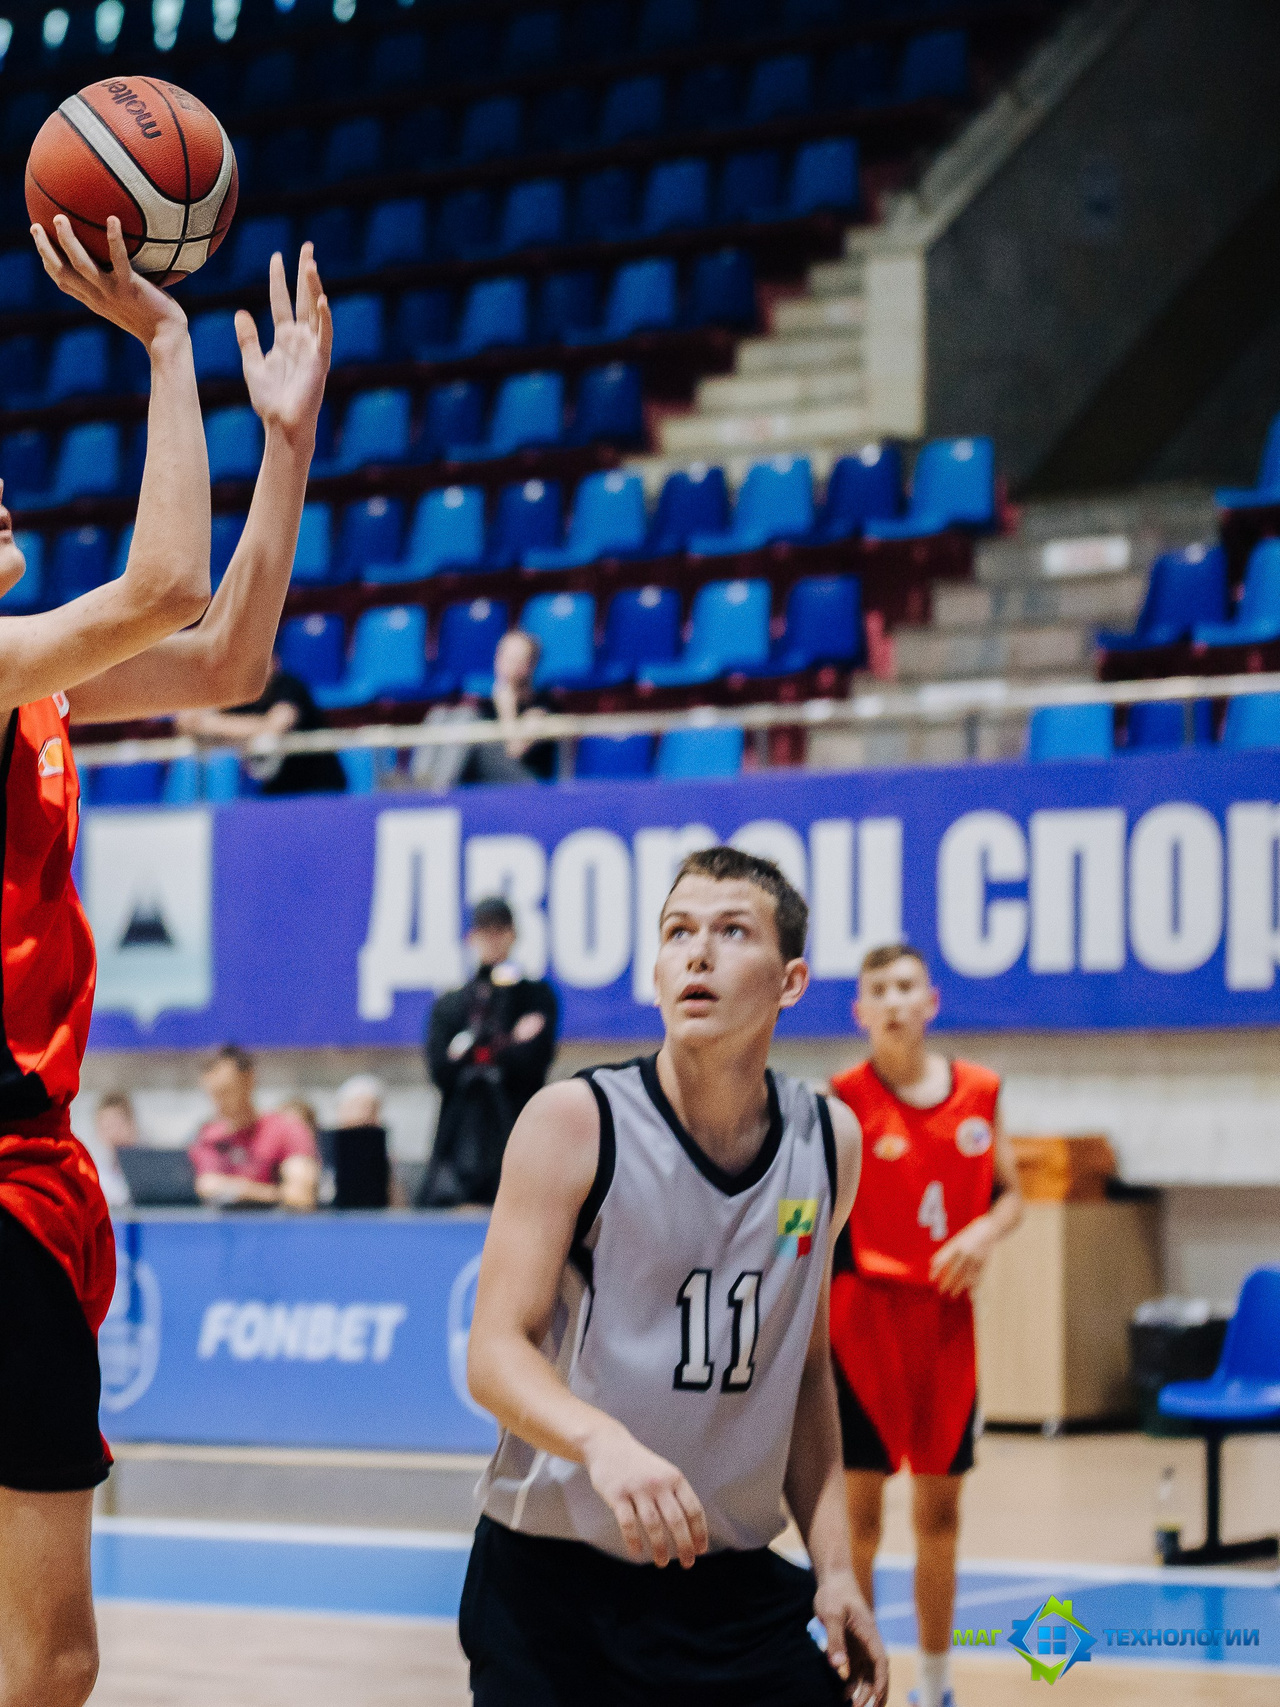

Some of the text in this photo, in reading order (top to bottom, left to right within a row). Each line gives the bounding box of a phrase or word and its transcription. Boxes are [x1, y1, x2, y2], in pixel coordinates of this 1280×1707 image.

[360, 807, 903, 1021] Дворц
[917, 1180, 949, 1242] 4
[198, 1301, 406, 1361] FONBET
[673, 1268, 763, 1393] 11
